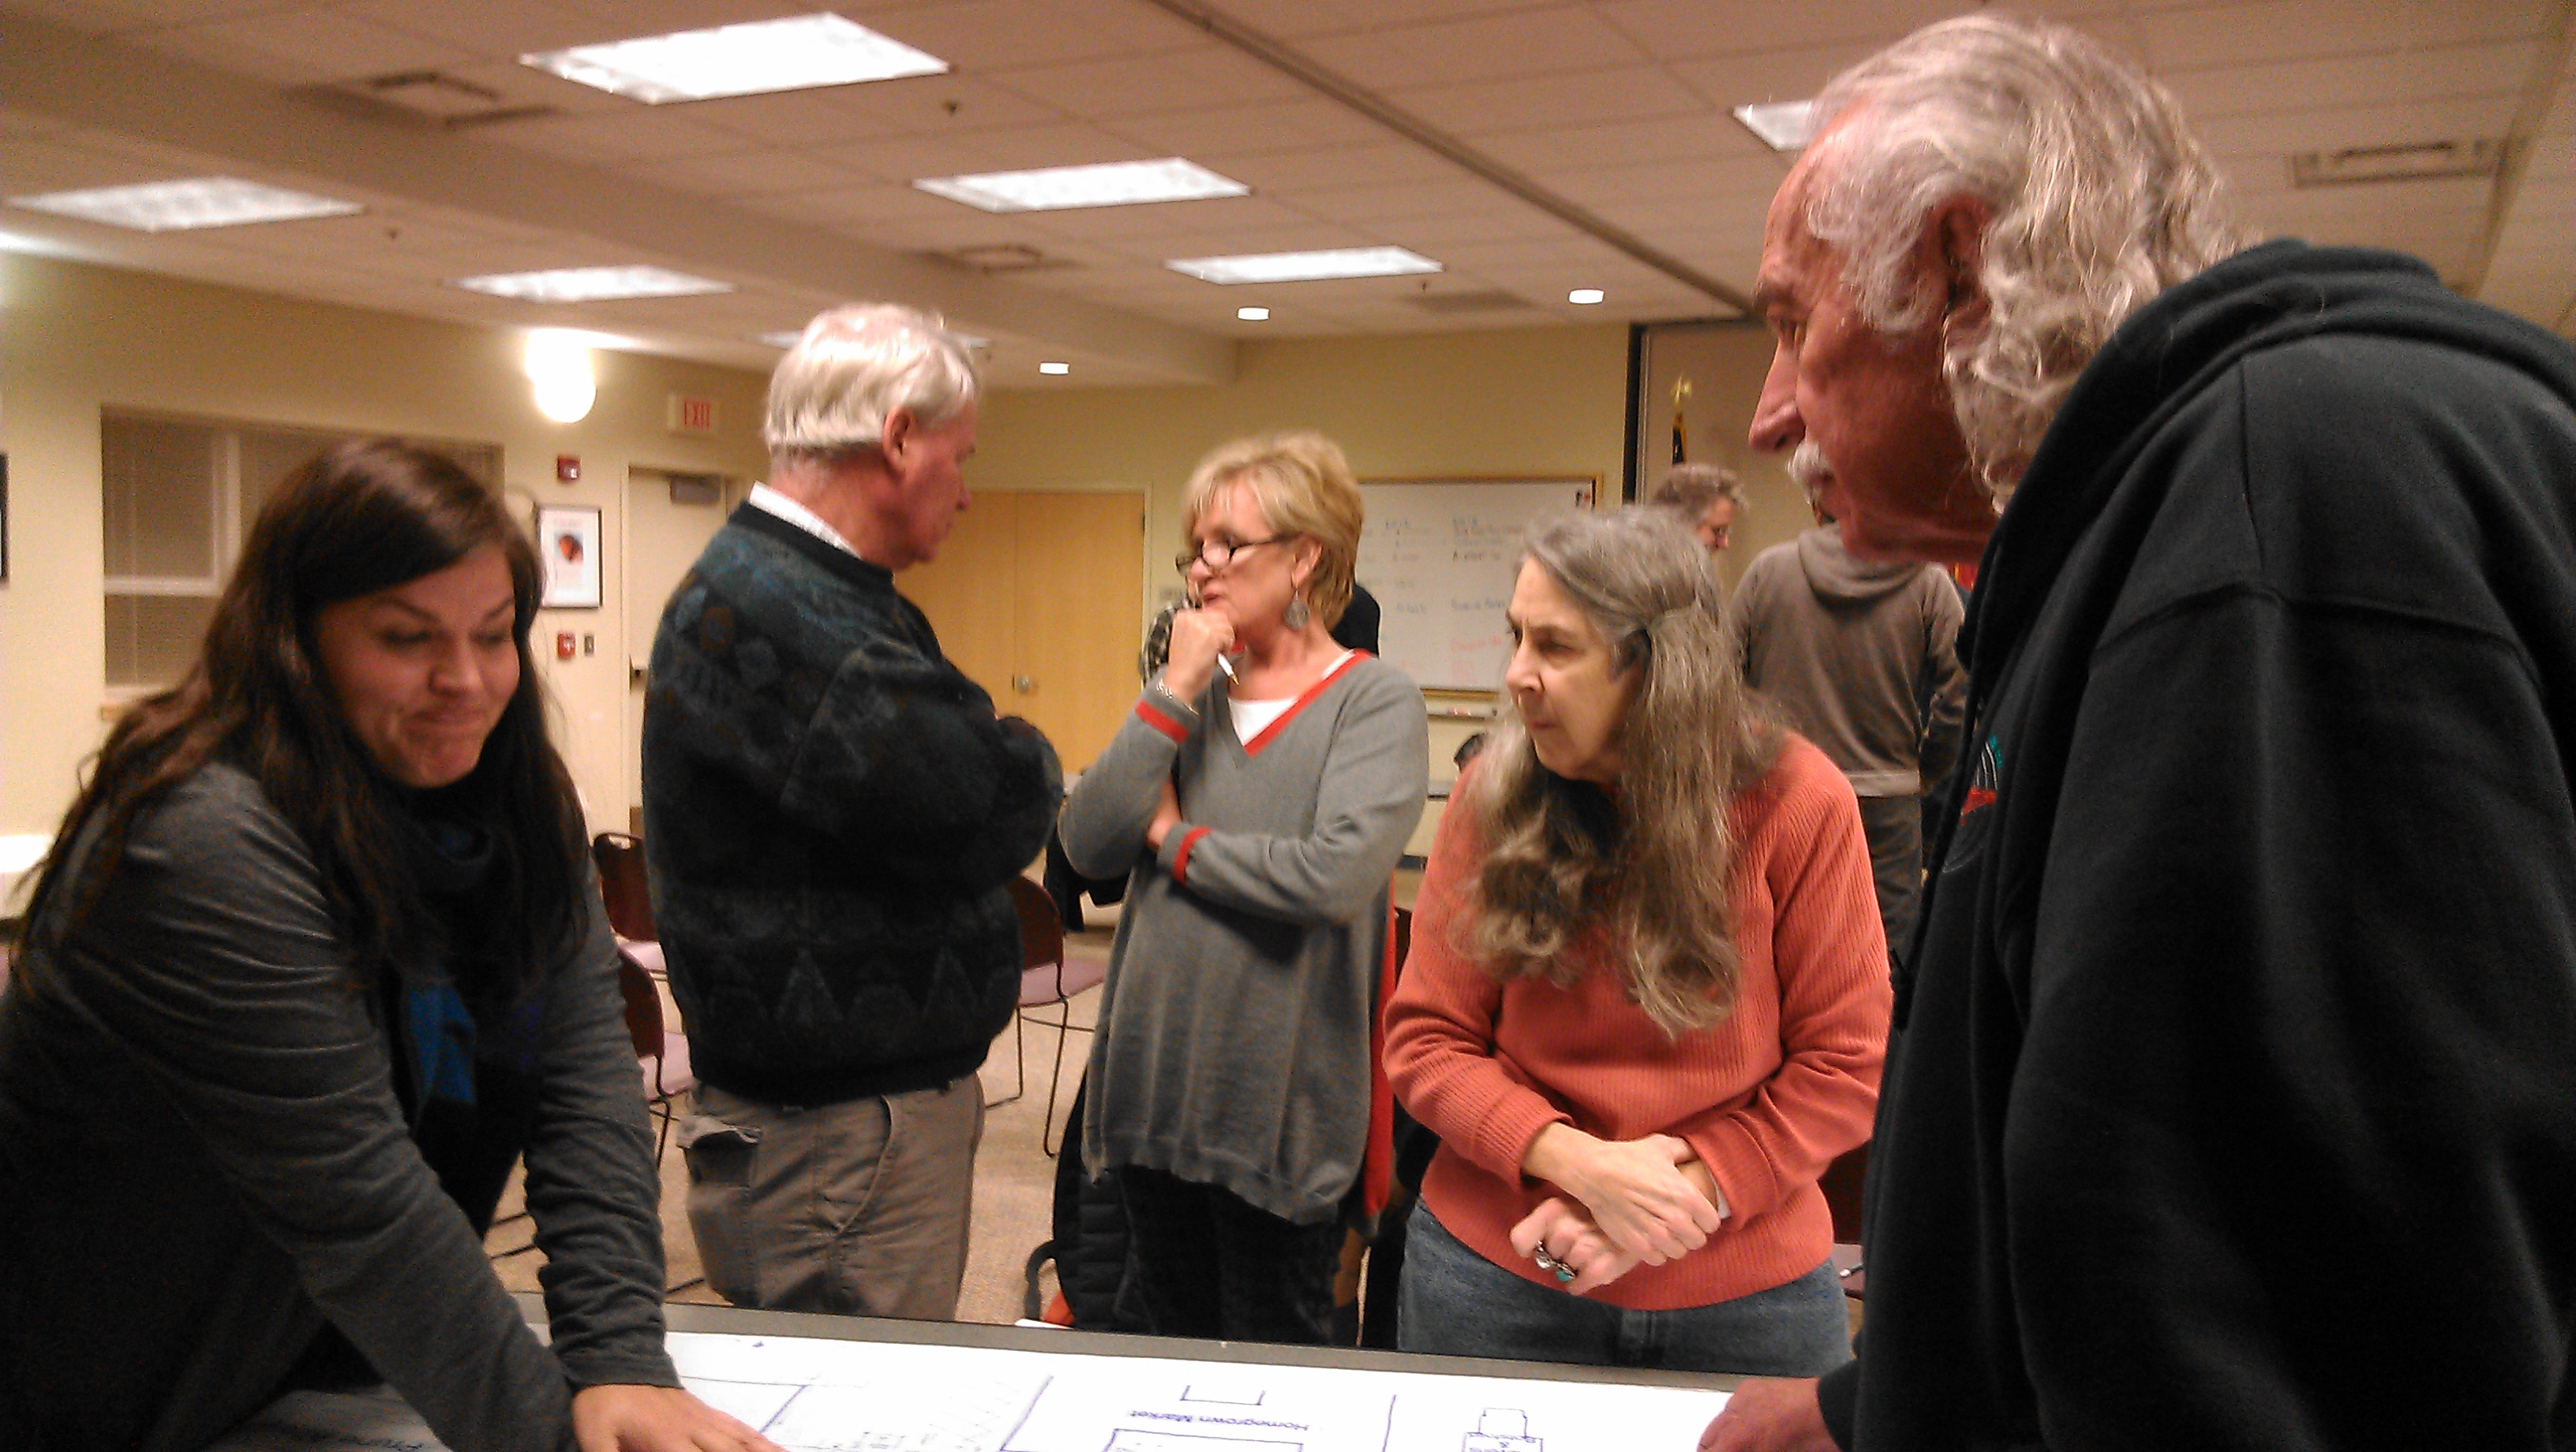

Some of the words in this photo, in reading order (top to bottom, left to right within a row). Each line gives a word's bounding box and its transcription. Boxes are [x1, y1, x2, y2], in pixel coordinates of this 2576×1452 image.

[683, 400, 710, 429] EXIT
[1129, 1409, 1193, 1423] Market
[1199, 1416, 1309, 1431] Homegrown
